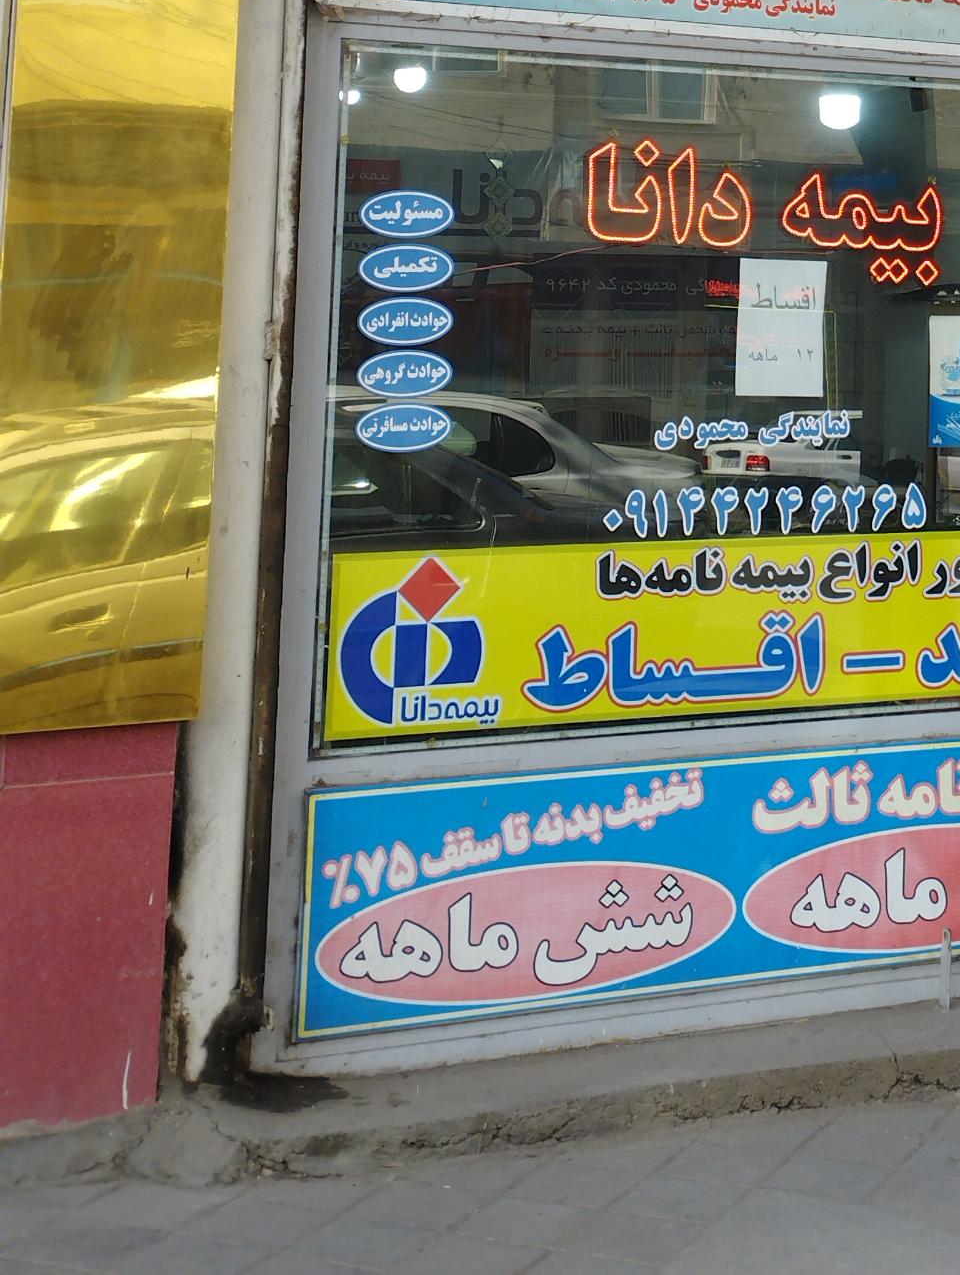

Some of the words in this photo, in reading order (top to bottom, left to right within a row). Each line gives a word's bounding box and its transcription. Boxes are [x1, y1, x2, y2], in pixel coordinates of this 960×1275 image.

[585, 138, 753, 248] دانا
[367, 200, 444, 226] مسئولیت
[781, 171, 944, 289] بیمه
[373, 256, 439, 279] تکمیلی
[596, 276, 618, 291] کد
[620, 279, 677, 296] محمودی
[750, 281, 817, 311] اقساط
[366, 312, 409, 332] انفرادی
[410, 312, 448, 331] حوادث
[407, 362, 447, 380] حوادث
[747, 347, 779, 364] ماهه
[796, 347, 814, 363] ۱۲
[364, 362, 406, 386] گروهی
[362, 415, 408, 438] مسافرتی
[409, 415, 448, 436] حوادث
[653, 415, 749, 452] محمودی
[757, 408, 852, 449] نمایندگی
[602, 481, 928, 540] ۰۹۱۴۴۲۴۶۲۶۵
[729, 553, 815, 604] بیمه
[816, 538, 923, 602] انواع
[520, 611, 827, 714] اقساط
[399, 695, 443, 724] دانا
[443, 696, 500, 725] بیمه
[603, 768, 704, 831] تخفیف
[751, 759, 873, 834] ثالث
[501, 811, 531, 855] تا
[532, 801, 603, 846] بدنه
[420, 826, 502, 879] سقف
[788, 846, 948, 934] ماهه
[338, 892, 521, 984] ماهه
[532, 873, 694, 987] شش
